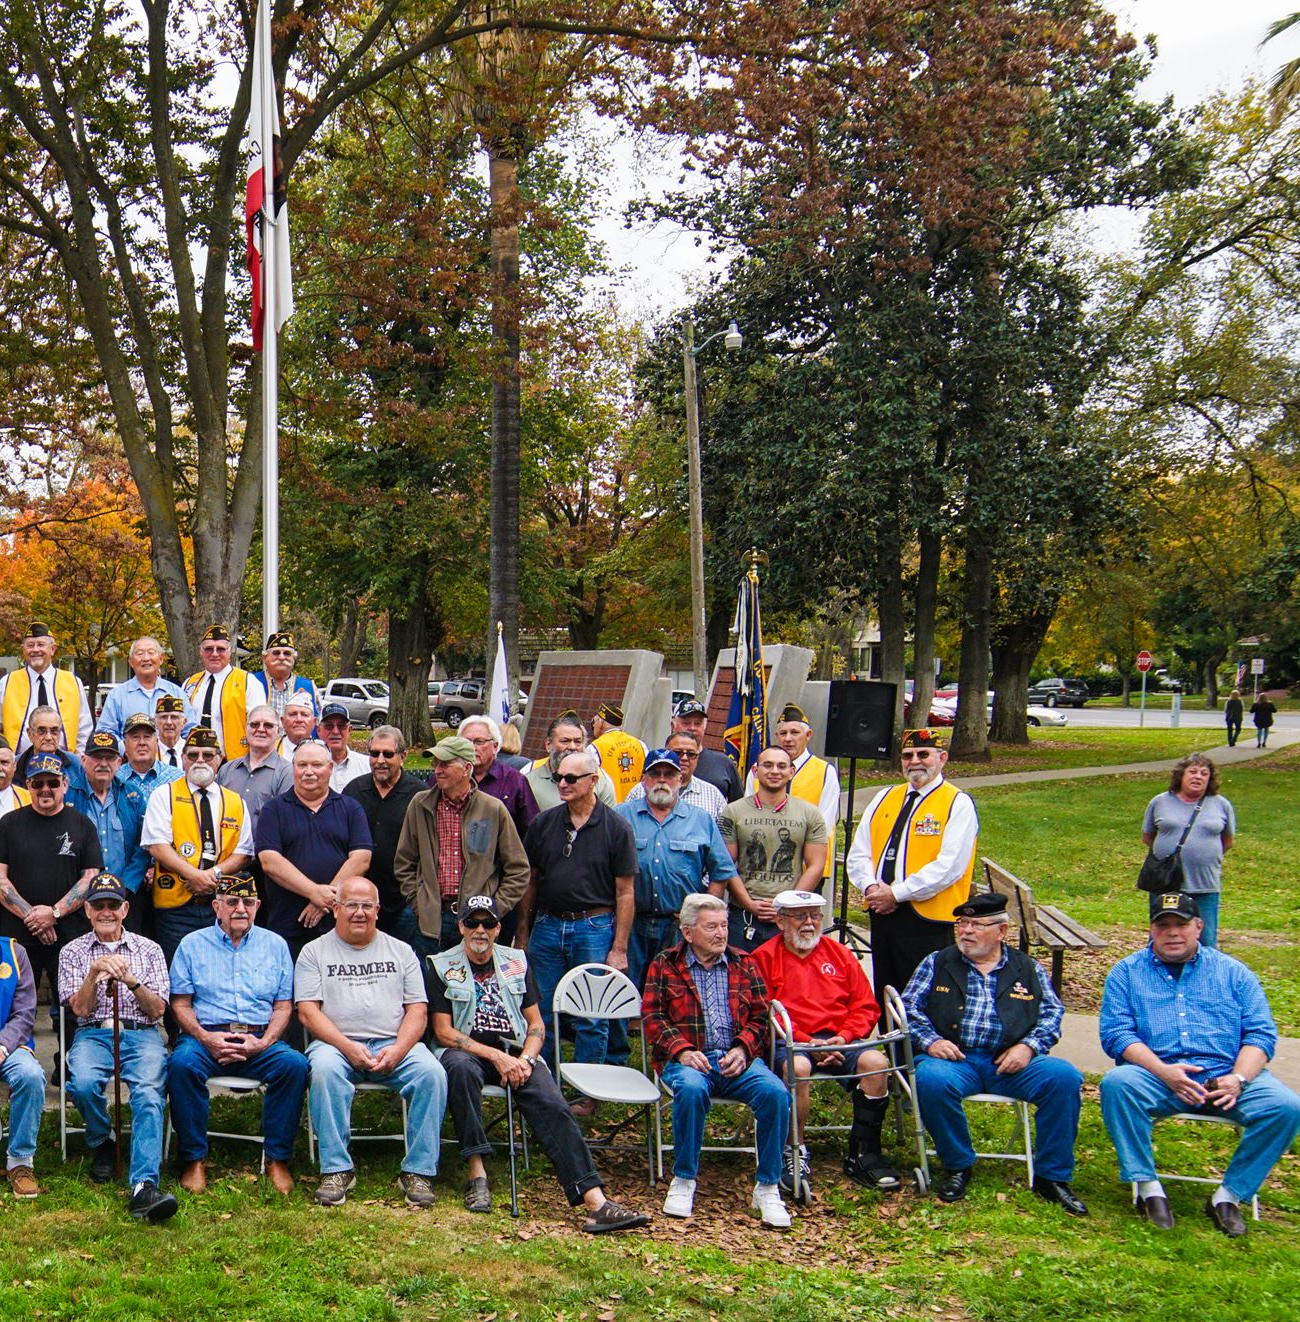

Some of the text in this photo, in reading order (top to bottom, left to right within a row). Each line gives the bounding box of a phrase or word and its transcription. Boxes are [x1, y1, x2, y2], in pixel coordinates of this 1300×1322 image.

[1137, 657, 1151, 666] STOP
[744, 817, 804, 829] LIBERTATEM
[326, 960, 397, 978] FARMER
